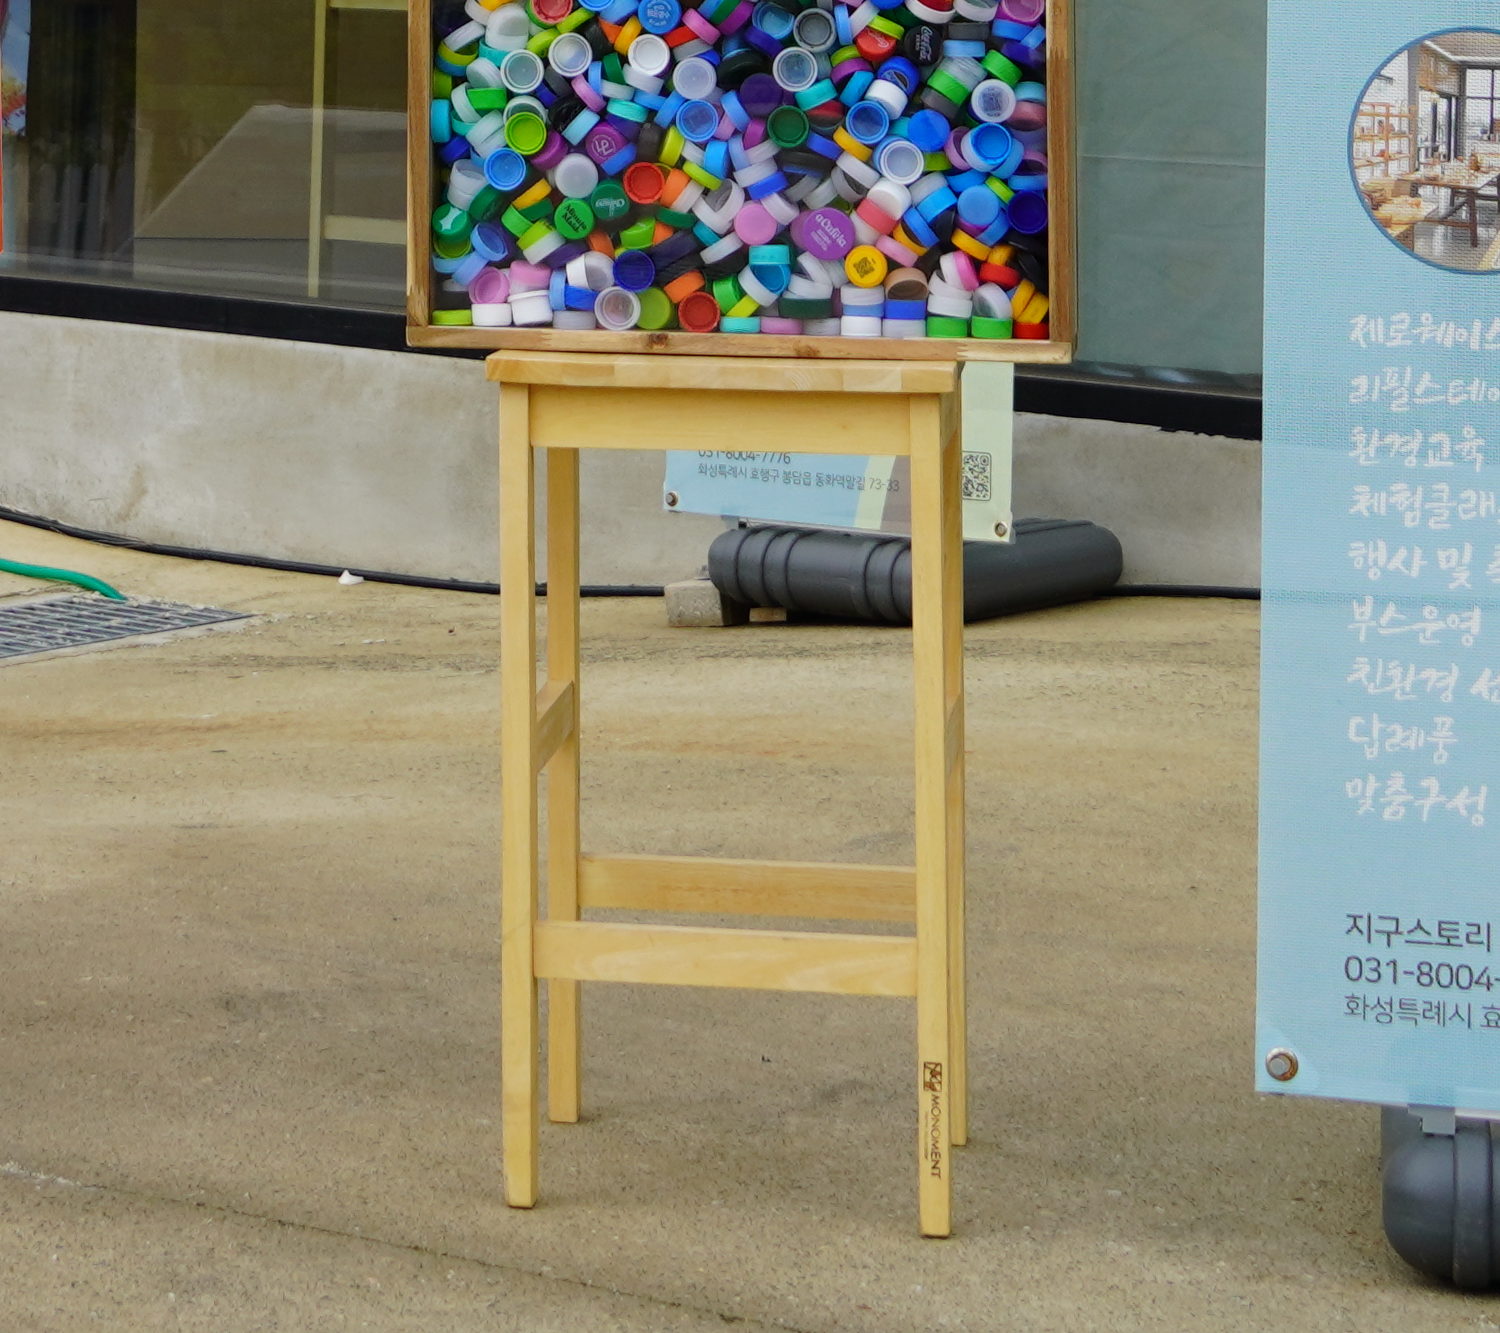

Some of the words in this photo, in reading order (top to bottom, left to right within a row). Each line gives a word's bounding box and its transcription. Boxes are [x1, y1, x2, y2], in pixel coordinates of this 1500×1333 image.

[1349, 424, 1485, 472] 환경교육
[698, 463, 748, 479] 화성특례시
[868, 477, 900, 492] 73-33
[1348, 539, 1428, 581] 행사
[1437, 541, 1473, 590] 및
[1348, 594, 1482, 646] 부스운영
[1346, 656, 1459, 703] 친환경
[1345, 771, 1487, 826] 맞춤구성
[1345, 913, 1491, 952] 지구스토리
[1344, 993, 1472, 1029] 화성특례시
